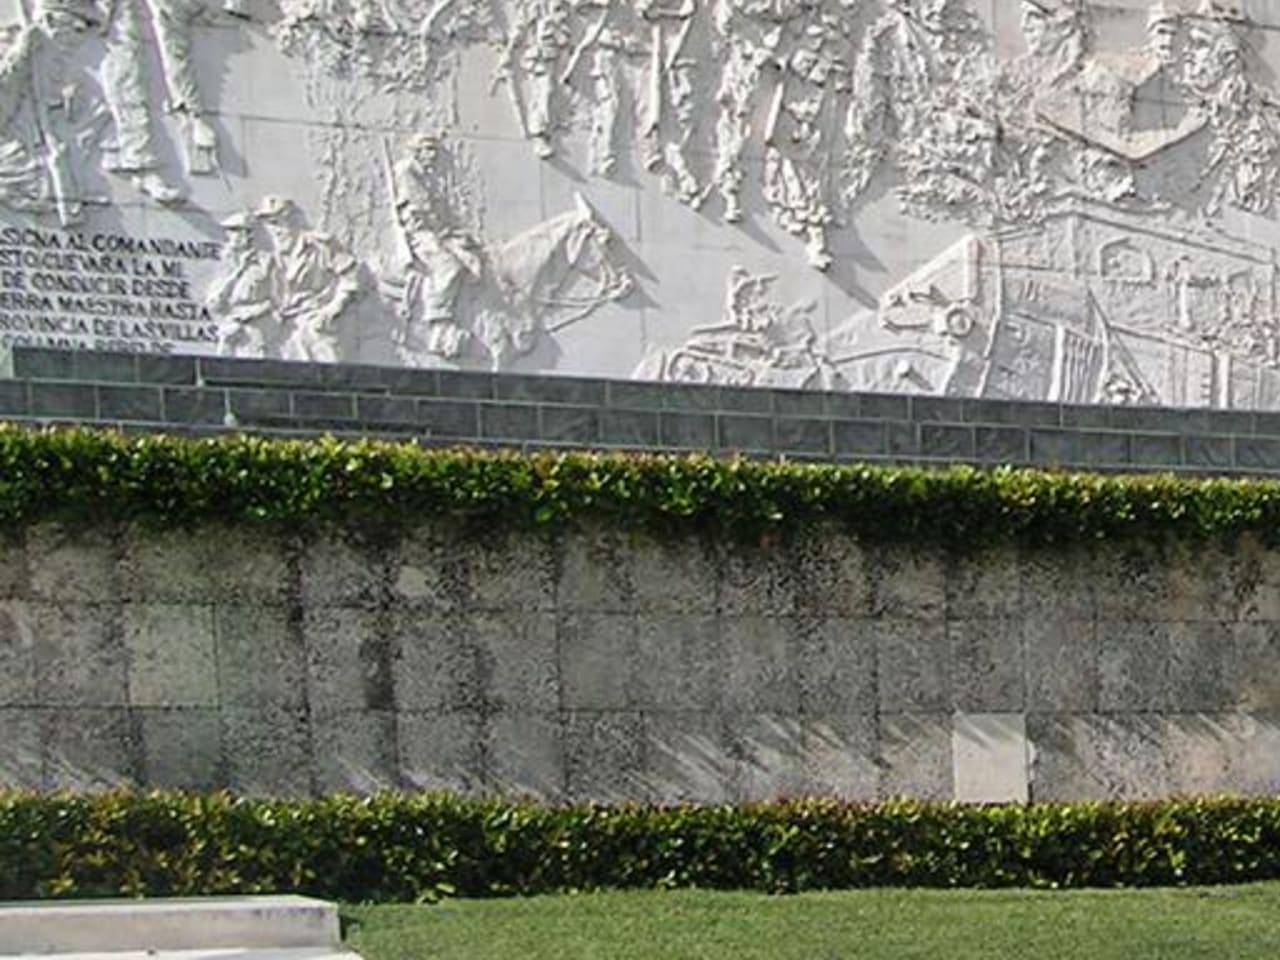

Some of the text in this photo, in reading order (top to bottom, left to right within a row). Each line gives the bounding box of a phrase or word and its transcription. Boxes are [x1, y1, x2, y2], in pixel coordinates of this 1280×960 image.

[92, 234, 222, 260] COMANDANTE
[132, 258, 157, 277] LA
[2, 270, 191, 299] DE CONDUCIR DESDE
[57, 295, 146, 317] MAESTRA
[150, 299, 212, 321] HASTA
[93, 318, 117, 337] DE
